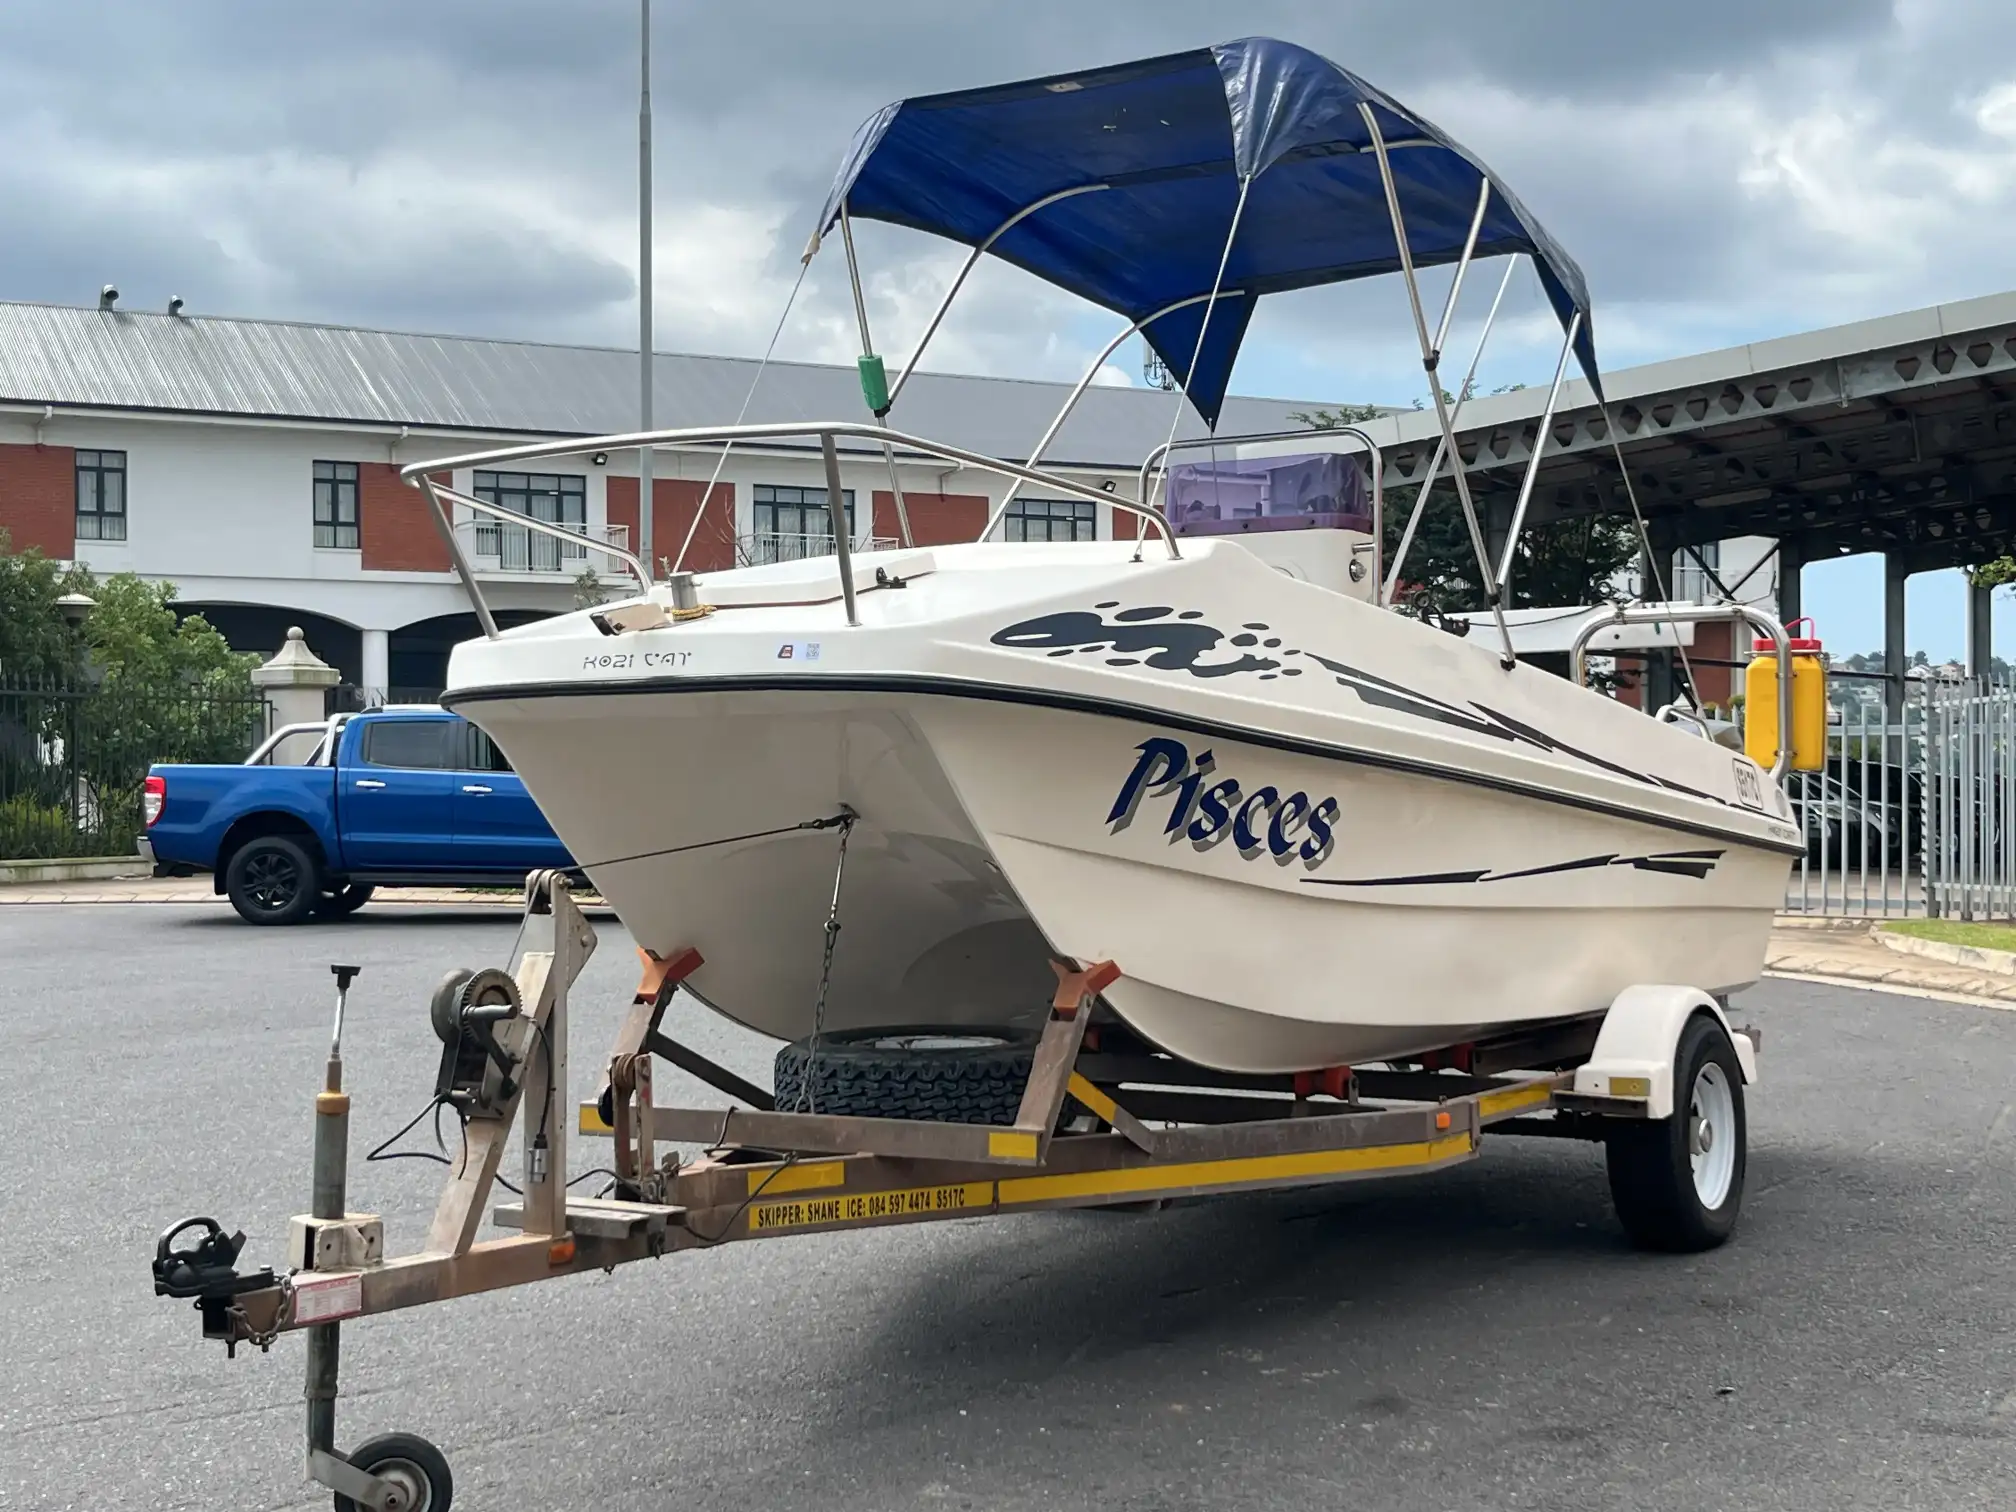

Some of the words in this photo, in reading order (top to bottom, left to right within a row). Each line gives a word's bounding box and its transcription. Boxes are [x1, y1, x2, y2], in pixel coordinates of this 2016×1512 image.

[645, 652, 692, 666] CAT
[1105, 737, 1341, 871] Pisces
[758, 1205, 804, 1228] SKIPPER:
[807, 1200, 840, 1222] SHANE
[847, 1198, 866, 1217] ICE:
[869, 1195, 886, 1216] 084
[889, 1193, 906, 1214] 597
[909, 1190, 931, 1211] 4474
